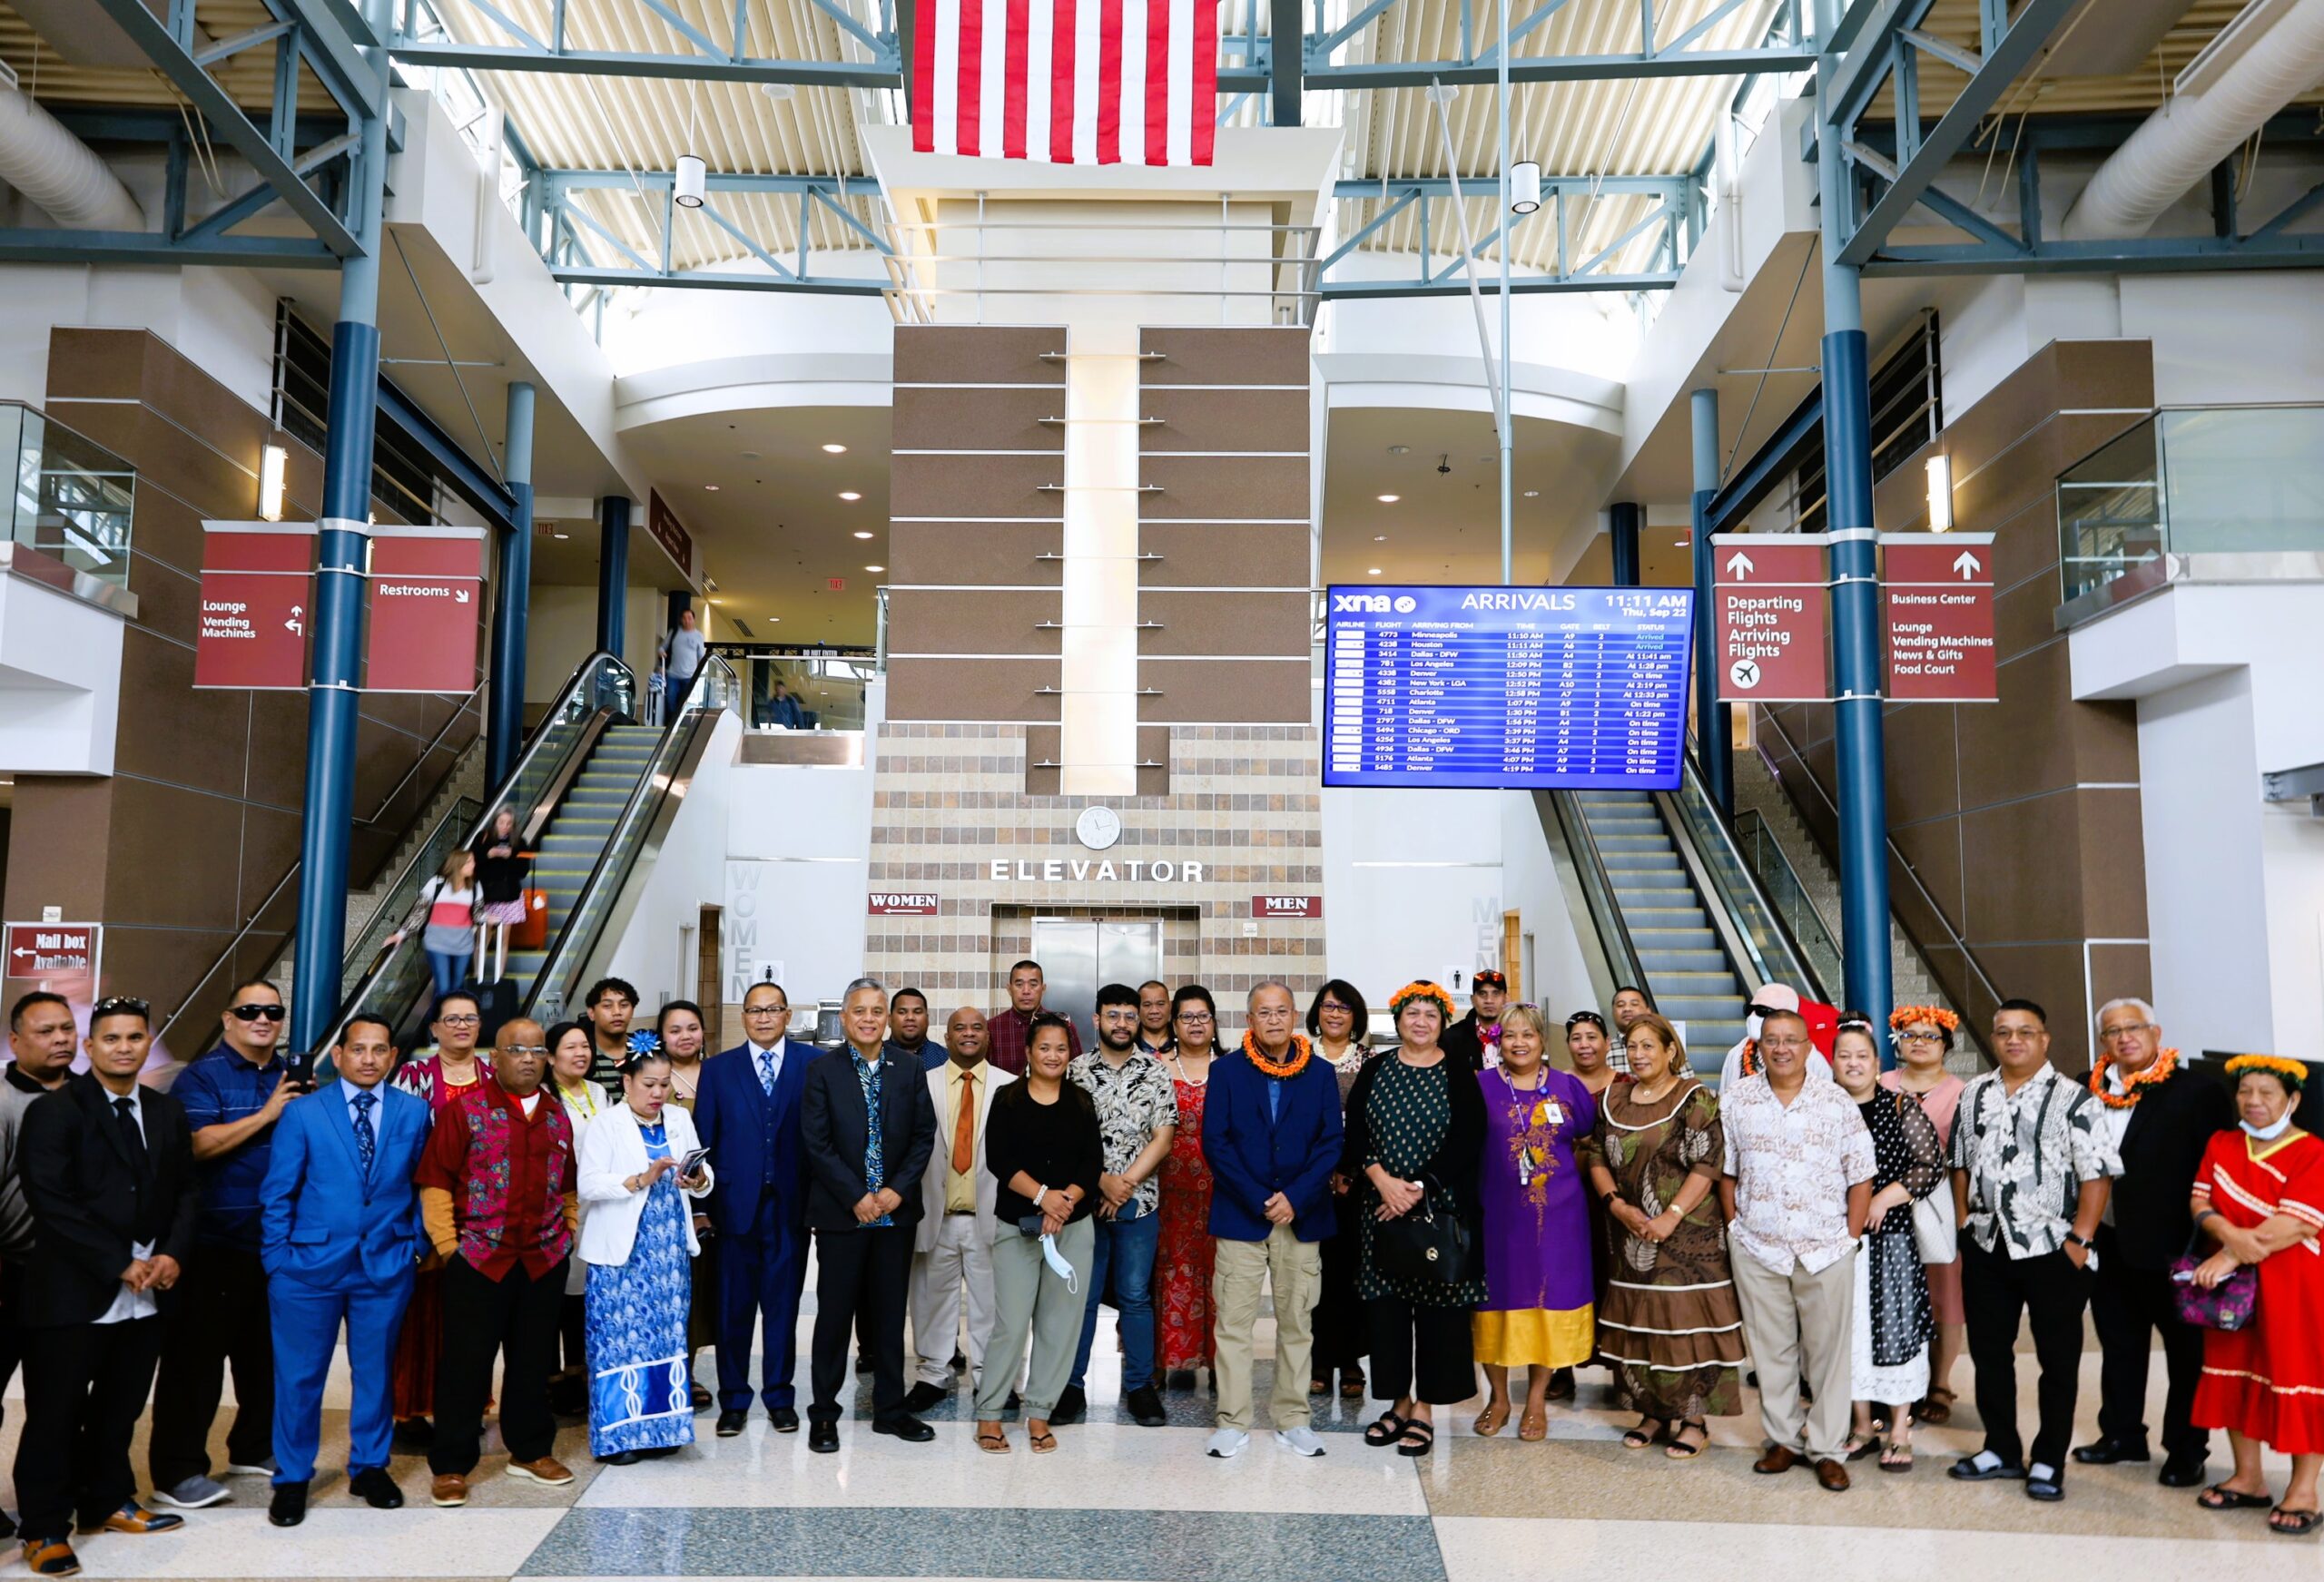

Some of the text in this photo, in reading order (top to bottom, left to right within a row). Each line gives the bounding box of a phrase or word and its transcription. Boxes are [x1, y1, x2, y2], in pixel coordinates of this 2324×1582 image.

[380, 585, 449, 596] Restrooms
[1334, 595, 1391, 612] xna
[1461, 594, 1576, 610] ARRIVALS
[1605, 595, 1687, 607] 11:11 AM
[1728, 596, 1802, 613] Departing
[1892, 594, 1975, 604] Business Center
[203, 600, 246, 614] Lounge
[1622, 608, 1687, 618] Thu, Sep 22
[203, 617, 250, 629] Vending
[1728, 611, 1777, 627] Flights
[202, 628, 255, 638] Machines
[1893, 623, 1932, 634] Lounge
[1412, 631, 1458, 640] Minneapolis
[1729, 628, 1789, 645] Arriving
[1893, 636, 1993, 648] Vending Machines
[1729, 644, 1780, 658] Flights
[1894, 650, 1963, 660] News & Gifts
[1425, 660, 1454, 669] Angeles
[1895, 663, 1955, 673] Food Court
[1408, 726, 1437, 735] Chicago
[1422, 736, 1451, 745] Angeles
[990, 858, 1203, 883] ELEVATOR
[871, 895, 938, 908] WOMEN
[1265, 897, 1308, 909] MEN
[731, 864, 763, 1002] WOMEN
[1472, 897, 1499, 972] MEN
[36, 934, 86, 948] Mail box
[34, 954, 86, 970] Available
